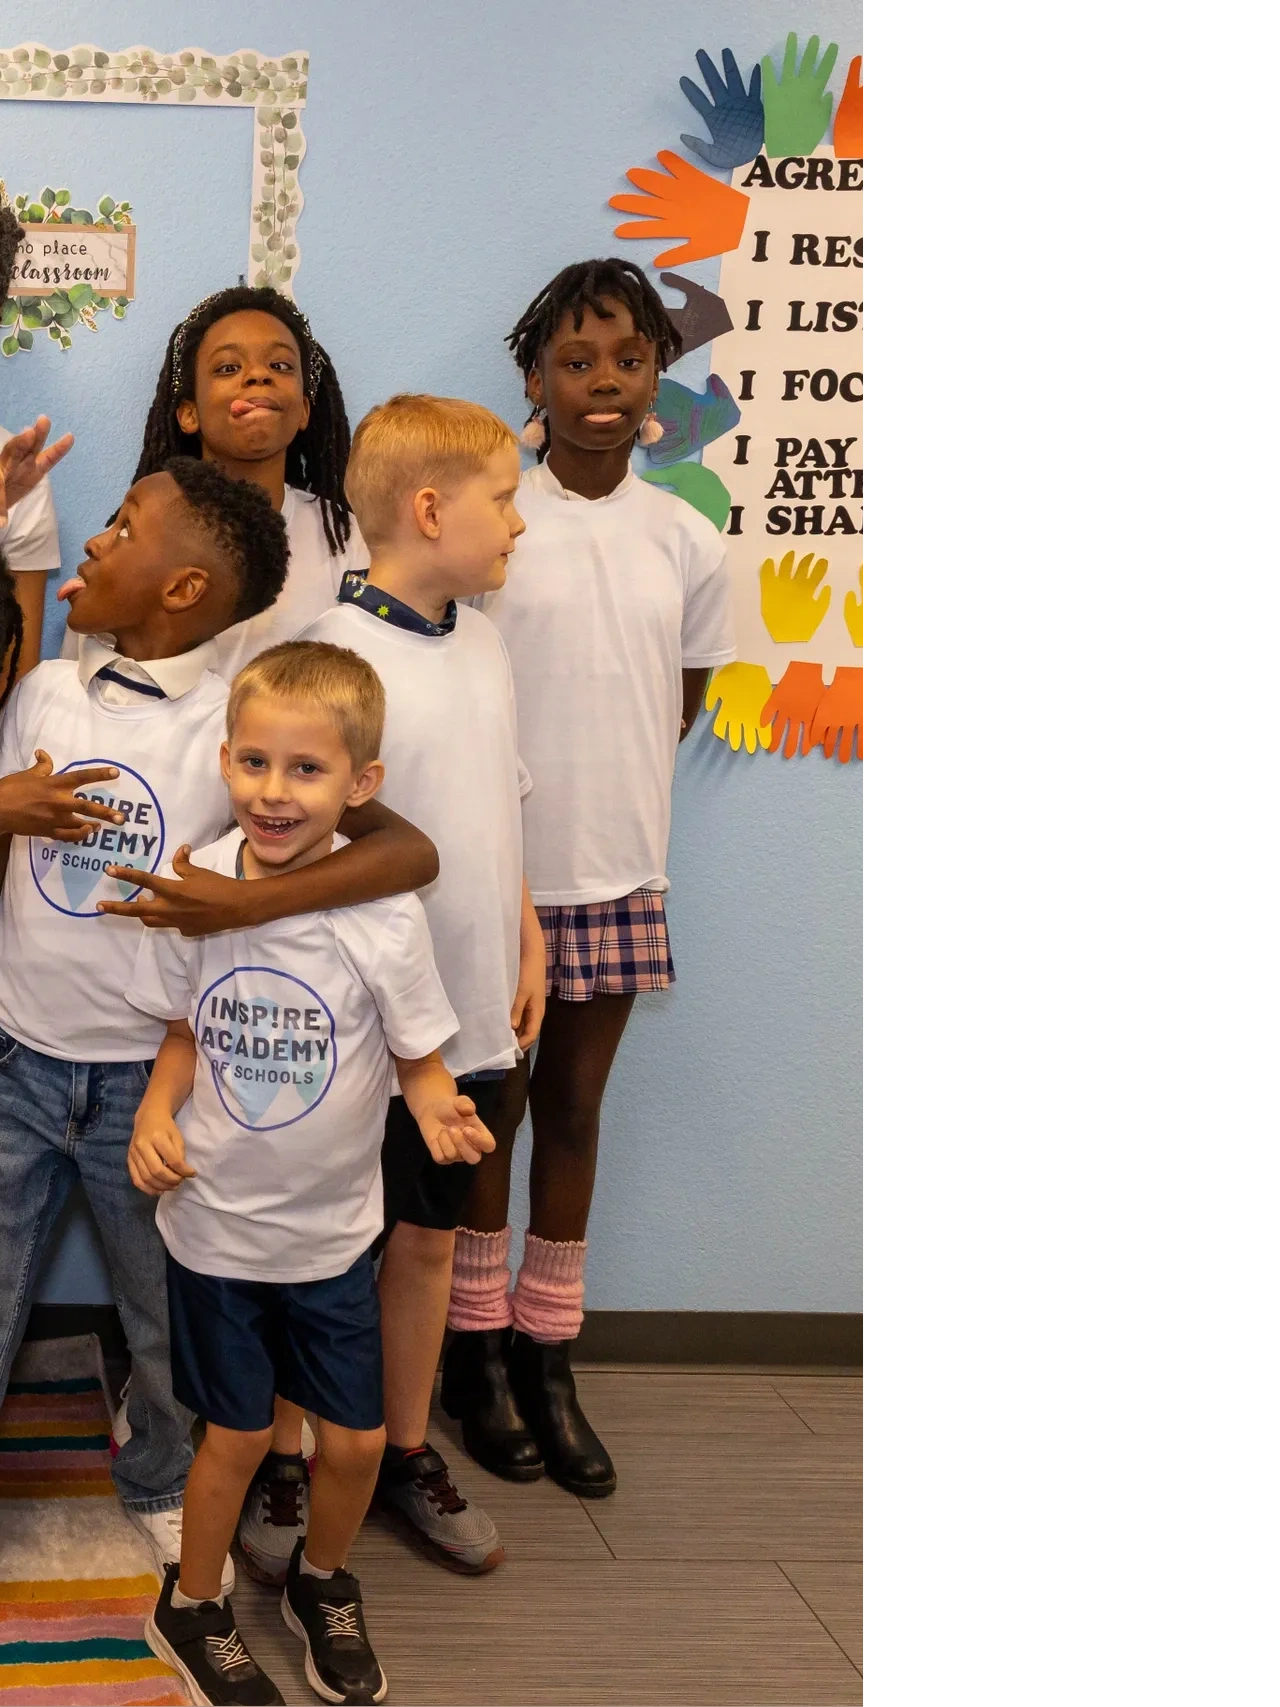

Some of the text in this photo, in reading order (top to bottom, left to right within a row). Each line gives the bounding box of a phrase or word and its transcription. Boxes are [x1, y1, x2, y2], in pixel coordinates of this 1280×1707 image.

[43, 239, 87, 256] place
[752, 230, 770, 262] I
[11, 259, 111, 284] classroom
[745, 300, 864, 332] I LIS
[738, 368, 864, 403] I FOC
[733, 434, 858, 468] I PAY
[727, 505, 864, 535] I SHA
[42, 847, 58, 863] OF
[210, 996, 321, 1030] INSP!RE
[200, 1026, 329, 1062] ACADEMY
[233, 1065, 314, 1085] SCHOOLS
